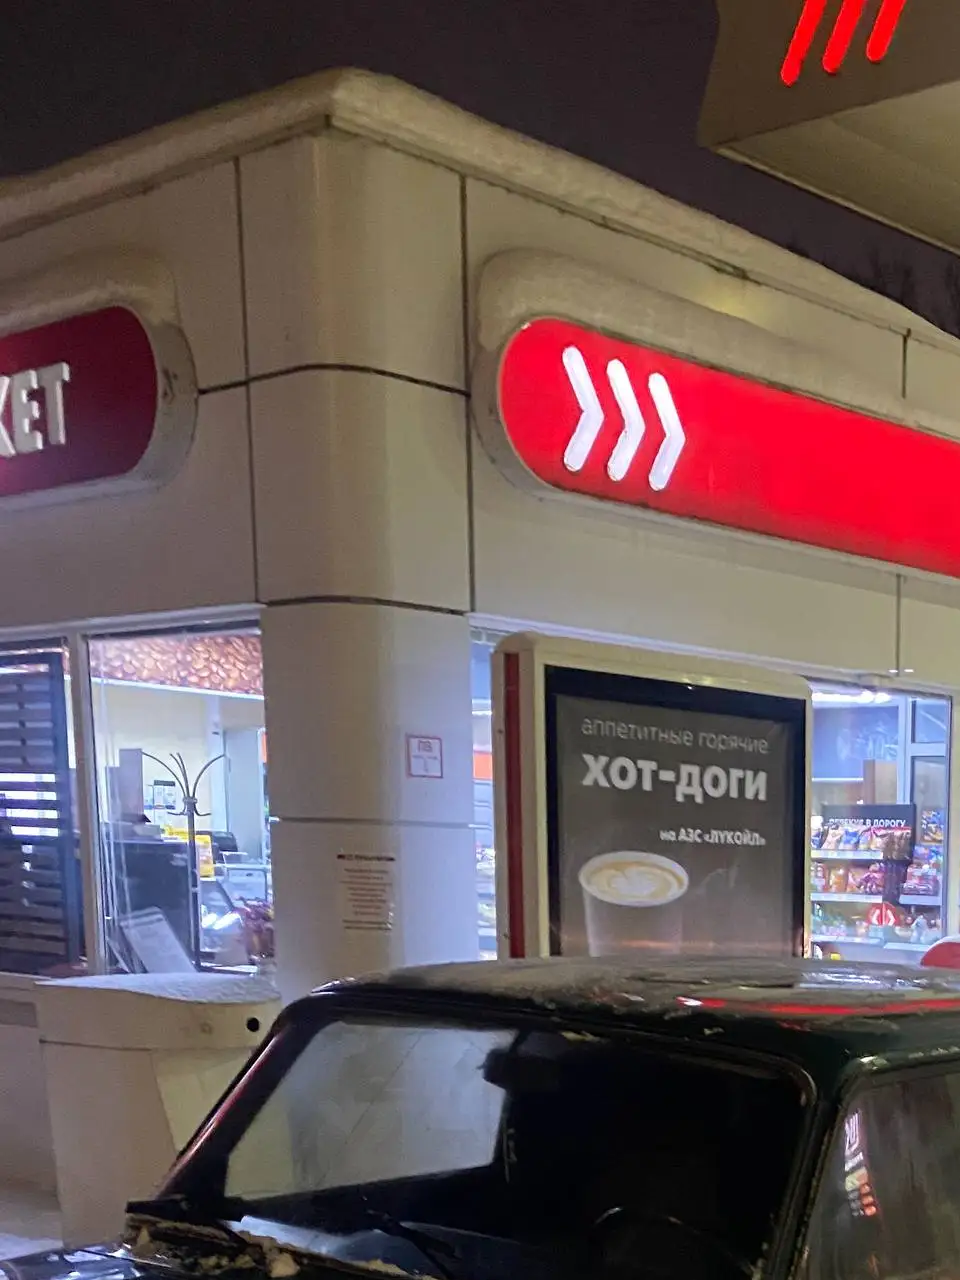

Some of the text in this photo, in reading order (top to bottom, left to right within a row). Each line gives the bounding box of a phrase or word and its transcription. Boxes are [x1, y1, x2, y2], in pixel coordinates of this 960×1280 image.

[581, 717, 769, 754] аппетитные горячие
[873, 818, 906, 828] ДОРОГУ
[659, 829, 676, 842] на
[678, 827, 703, 843] АЗС
